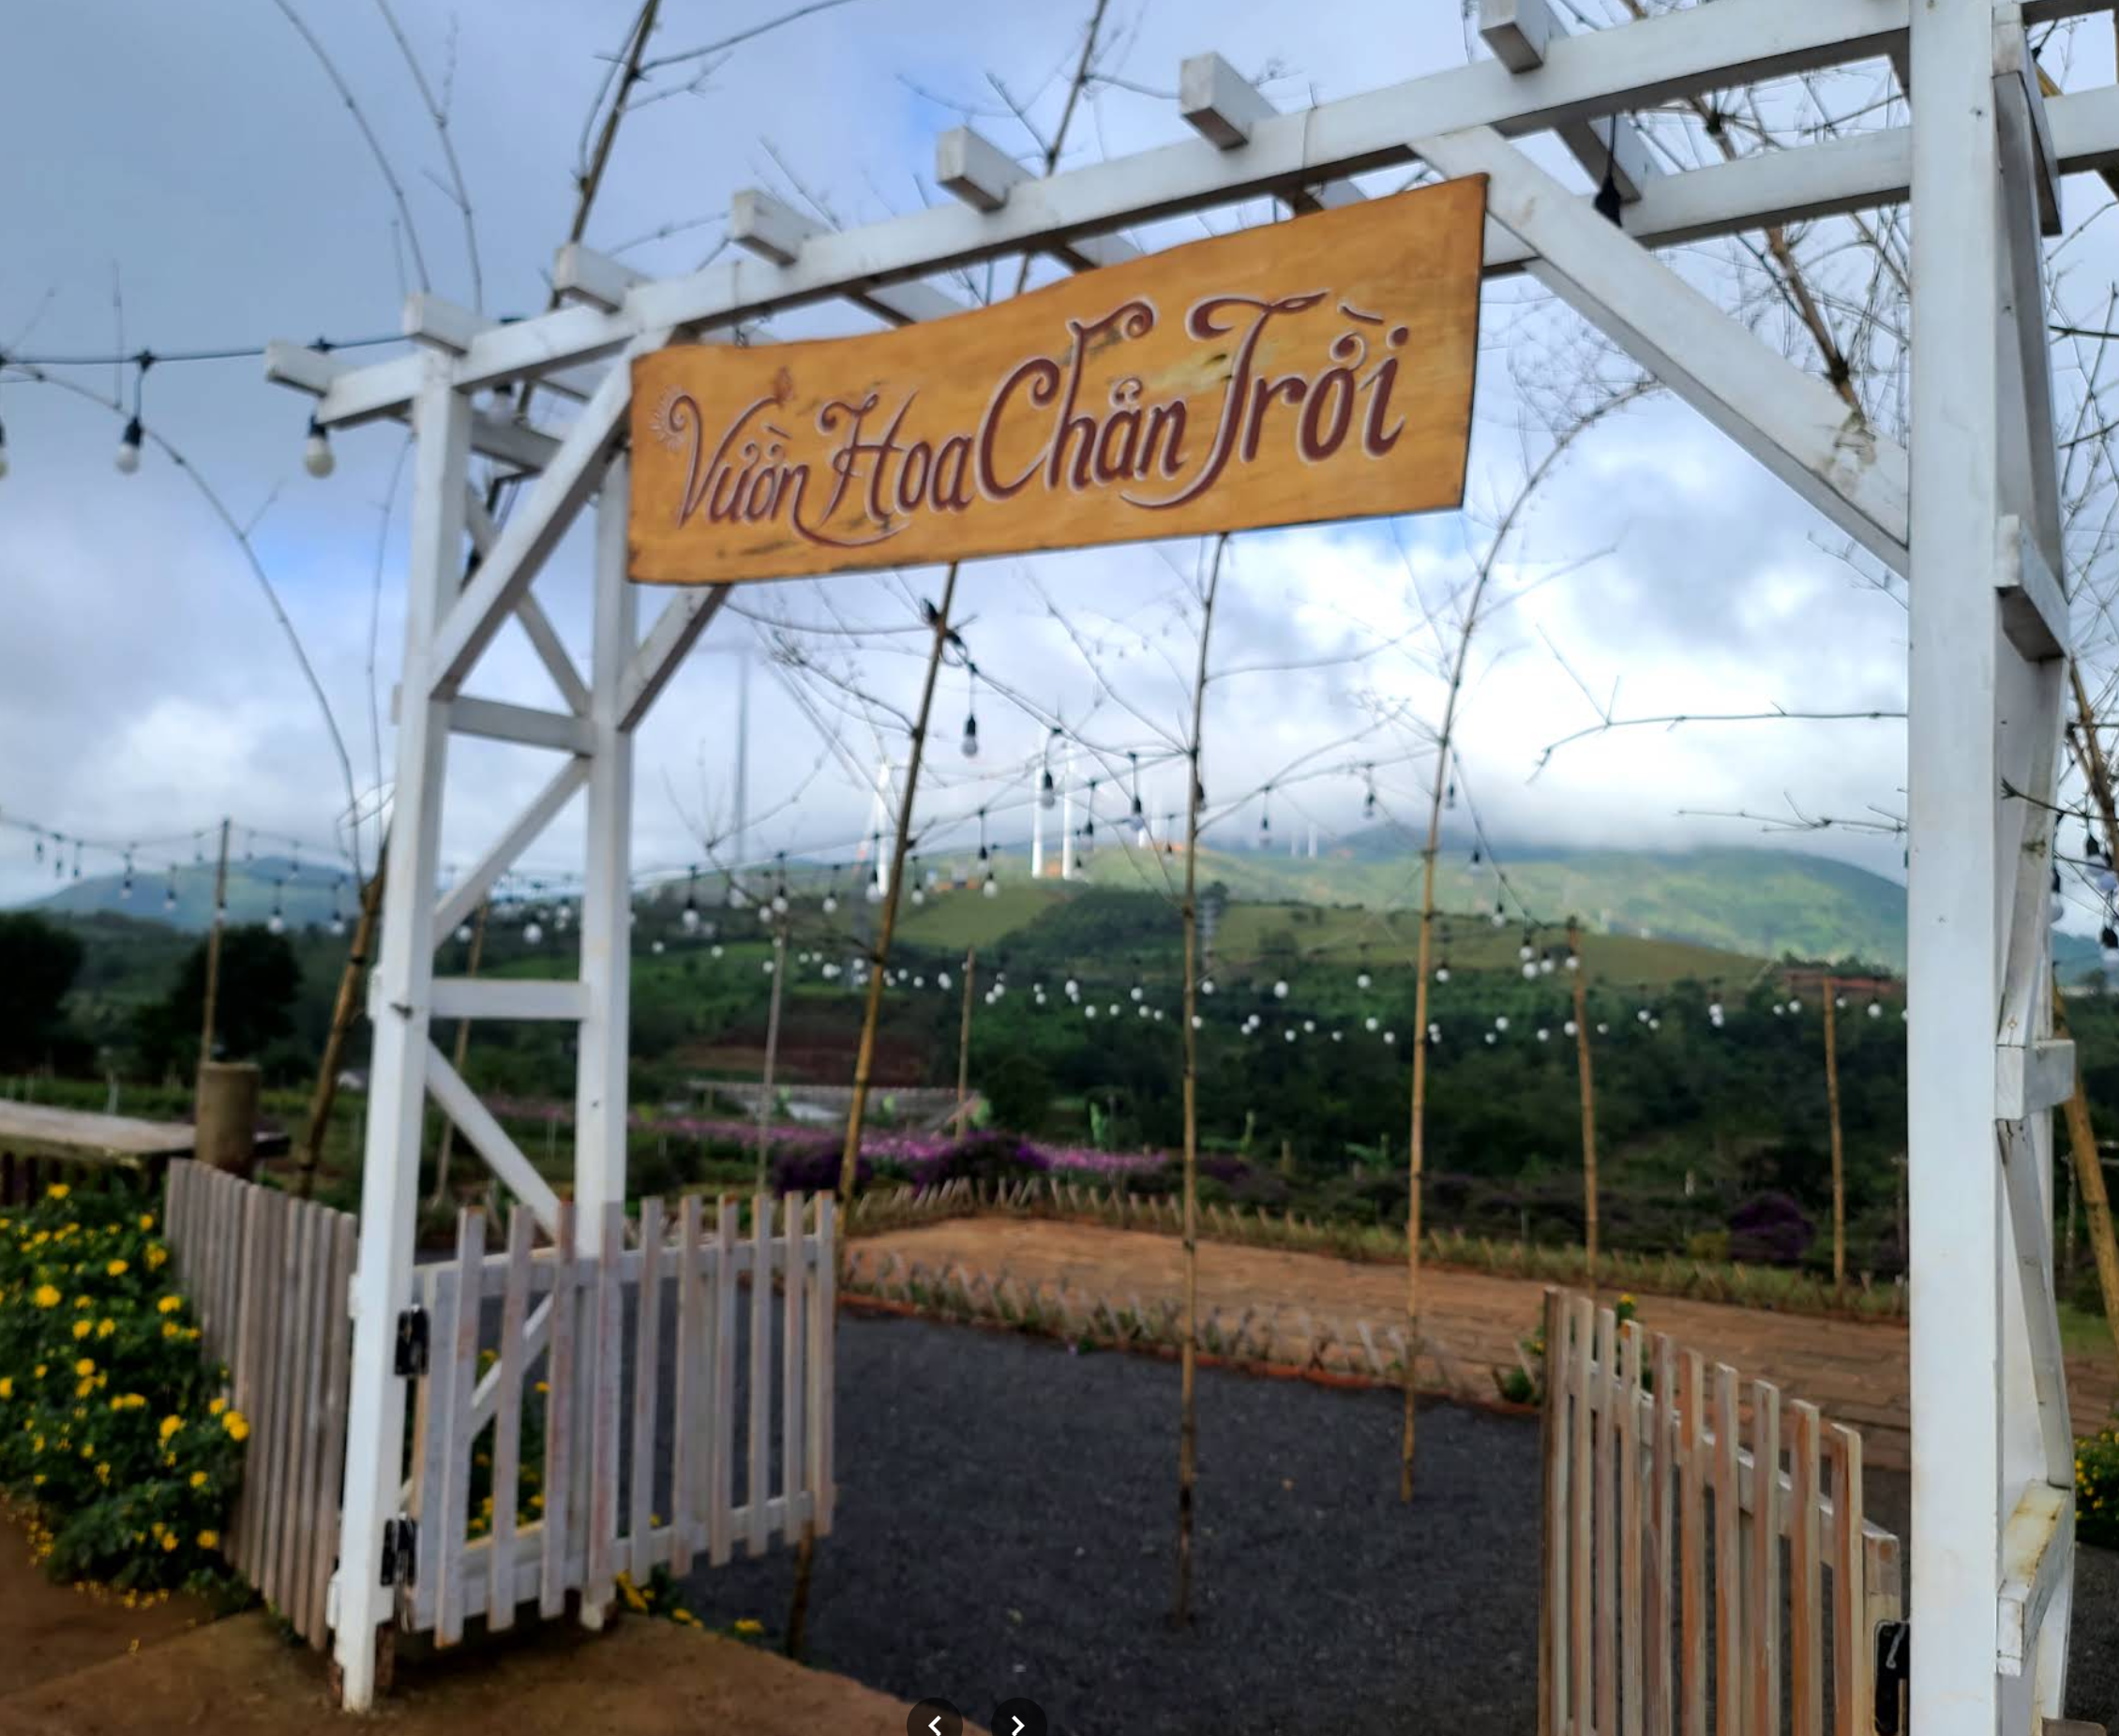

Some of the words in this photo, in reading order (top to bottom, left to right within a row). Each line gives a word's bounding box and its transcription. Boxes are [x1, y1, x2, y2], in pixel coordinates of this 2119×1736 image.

[667, 393, 910, 547] Vườn
[816, 386, 973, 528] Hoa
[975, 293, 1191, 502] Chân
[1120, 288, 1409, 510] Trời
